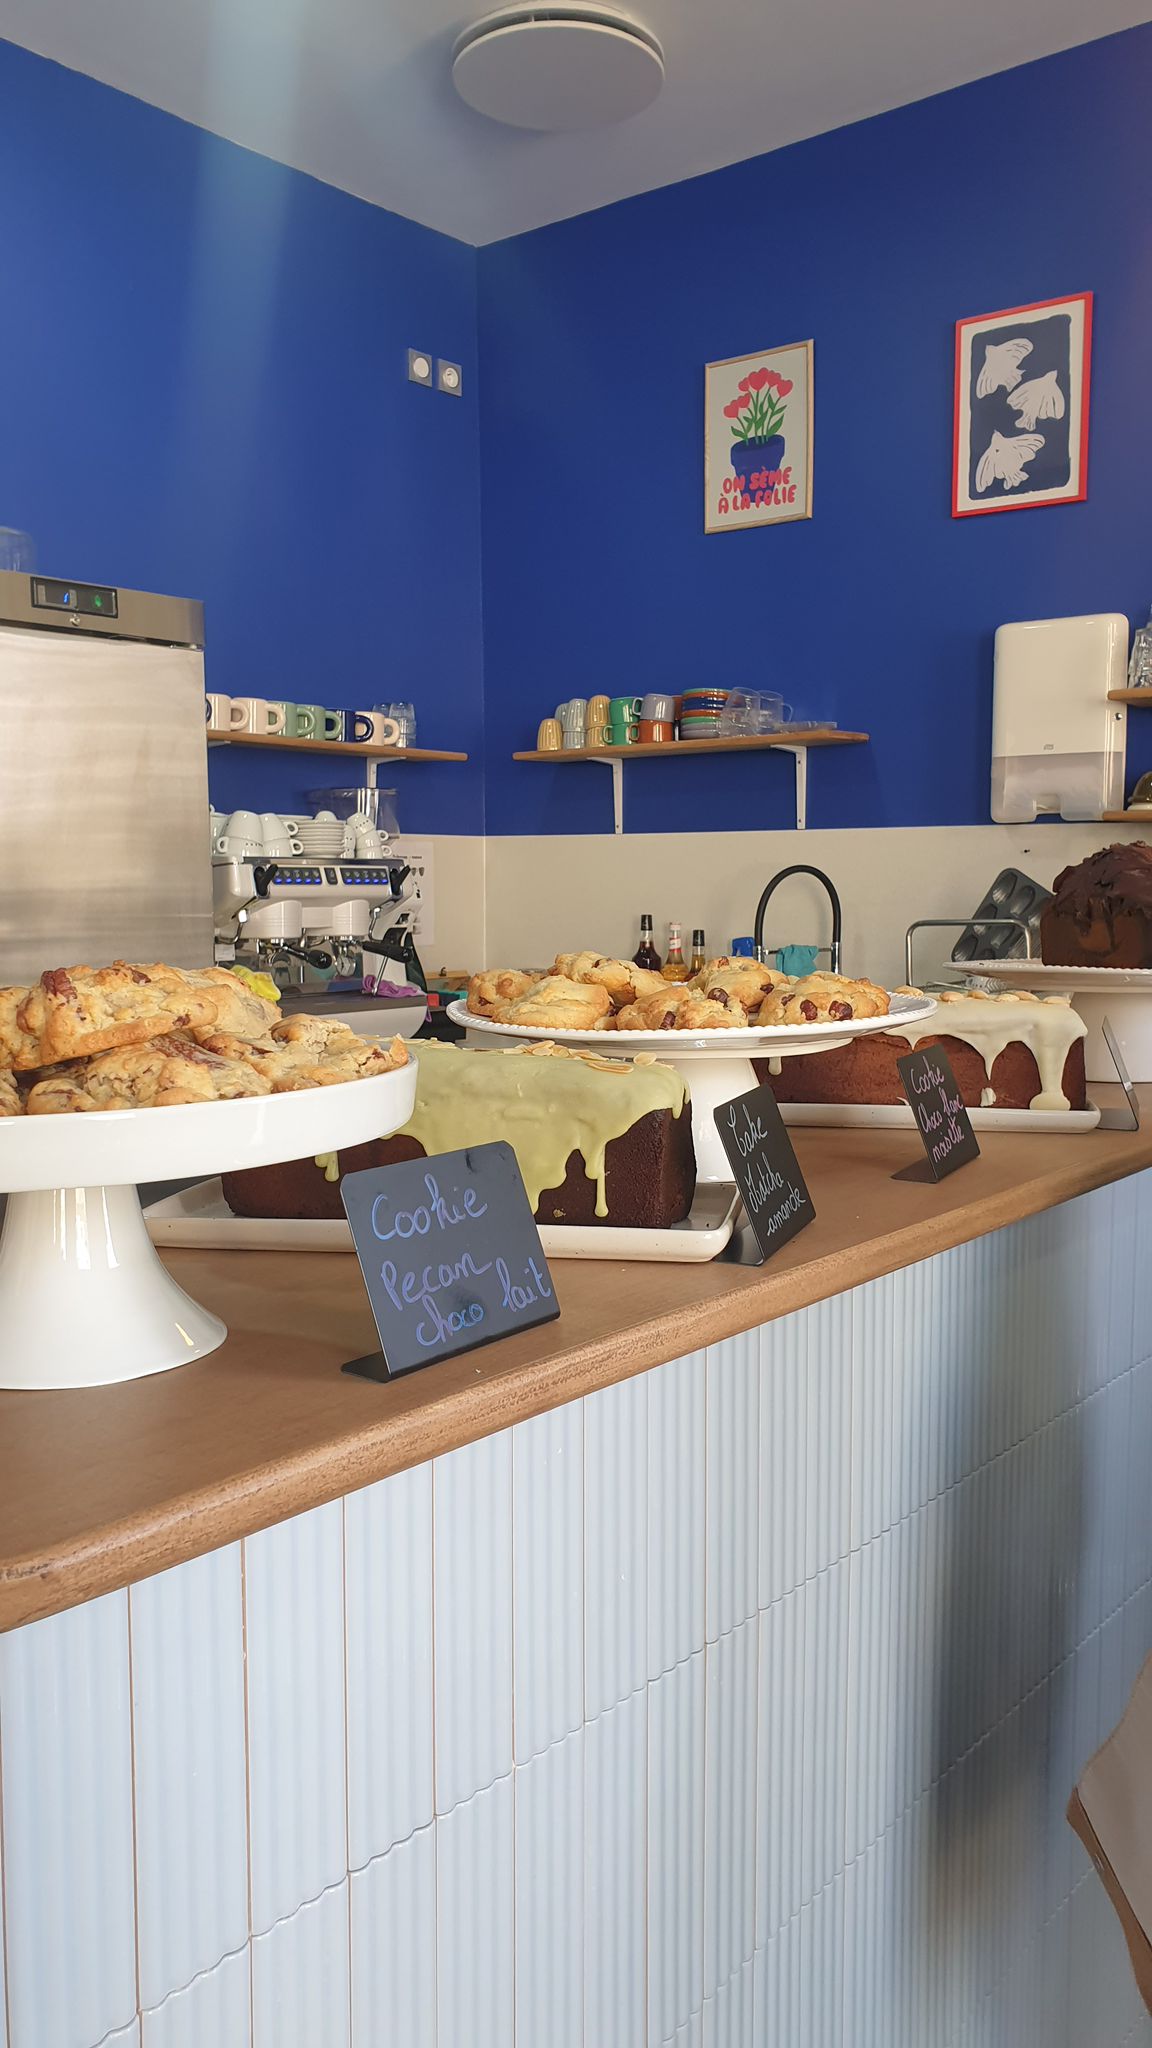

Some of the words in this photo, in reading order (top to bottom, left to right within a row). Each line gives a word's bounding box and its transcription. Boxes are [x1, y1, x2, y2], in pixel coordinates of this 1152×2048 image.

[718, 493, 729, 514] À
[732, 493, 751, 511] LA
[755, 484, 797, 509] FOLIE
[722, 474, 746, 495] ON
[748, 465, 792, 491] SÈME
[909, 1055, 945, 1095] Cookie
[726, 1104, 768, 1158] Cake
[932, 1115, 965, 1163] noisette
[371, 1173, 488, 1241] Cookie
[766, 1181, 807, 1237] amande
[495, 1256, 551, 1313] lait
